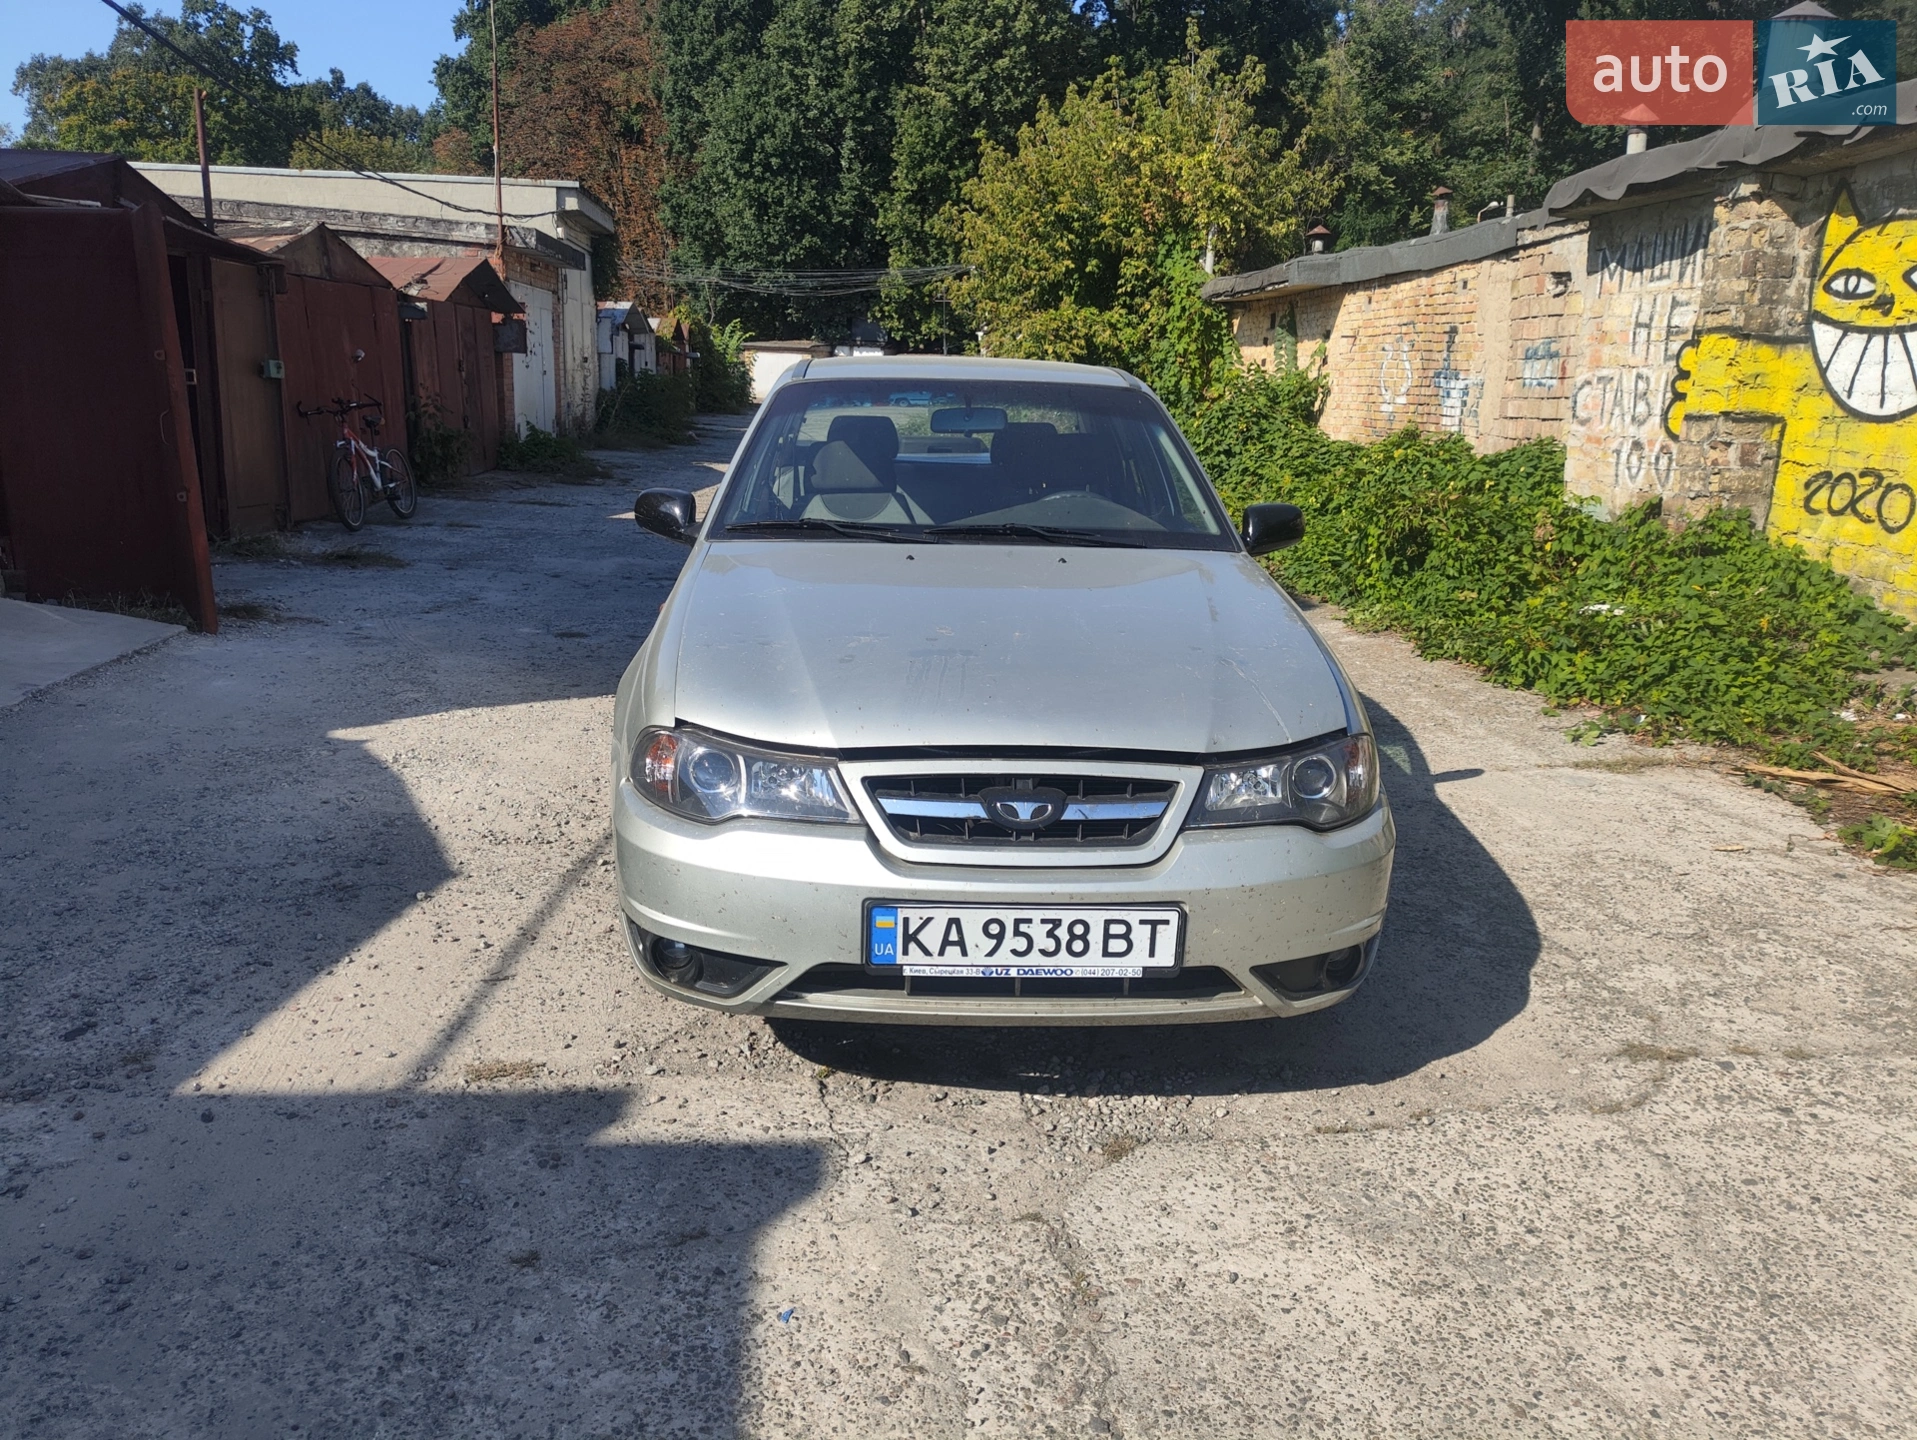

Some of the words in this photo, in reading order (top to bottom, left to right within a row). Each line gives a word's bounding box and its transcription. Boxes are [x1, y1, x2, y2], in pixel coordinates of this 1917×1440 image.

[1803, 470, 1917, 535] 2020
[901, 916, 969, 958] KA
[981, 917, 1091, 959] 9538
[1101, 918, 1171, 959] BT
[874, 942, 895, 957] UA
[994, 967, 1012, 976] UZ
[1017, 968, 1075, 977] DAEWOO
[1080, 967, 1100, 977] (044)
[1101, 968, 1142, 977] 207-02-50
